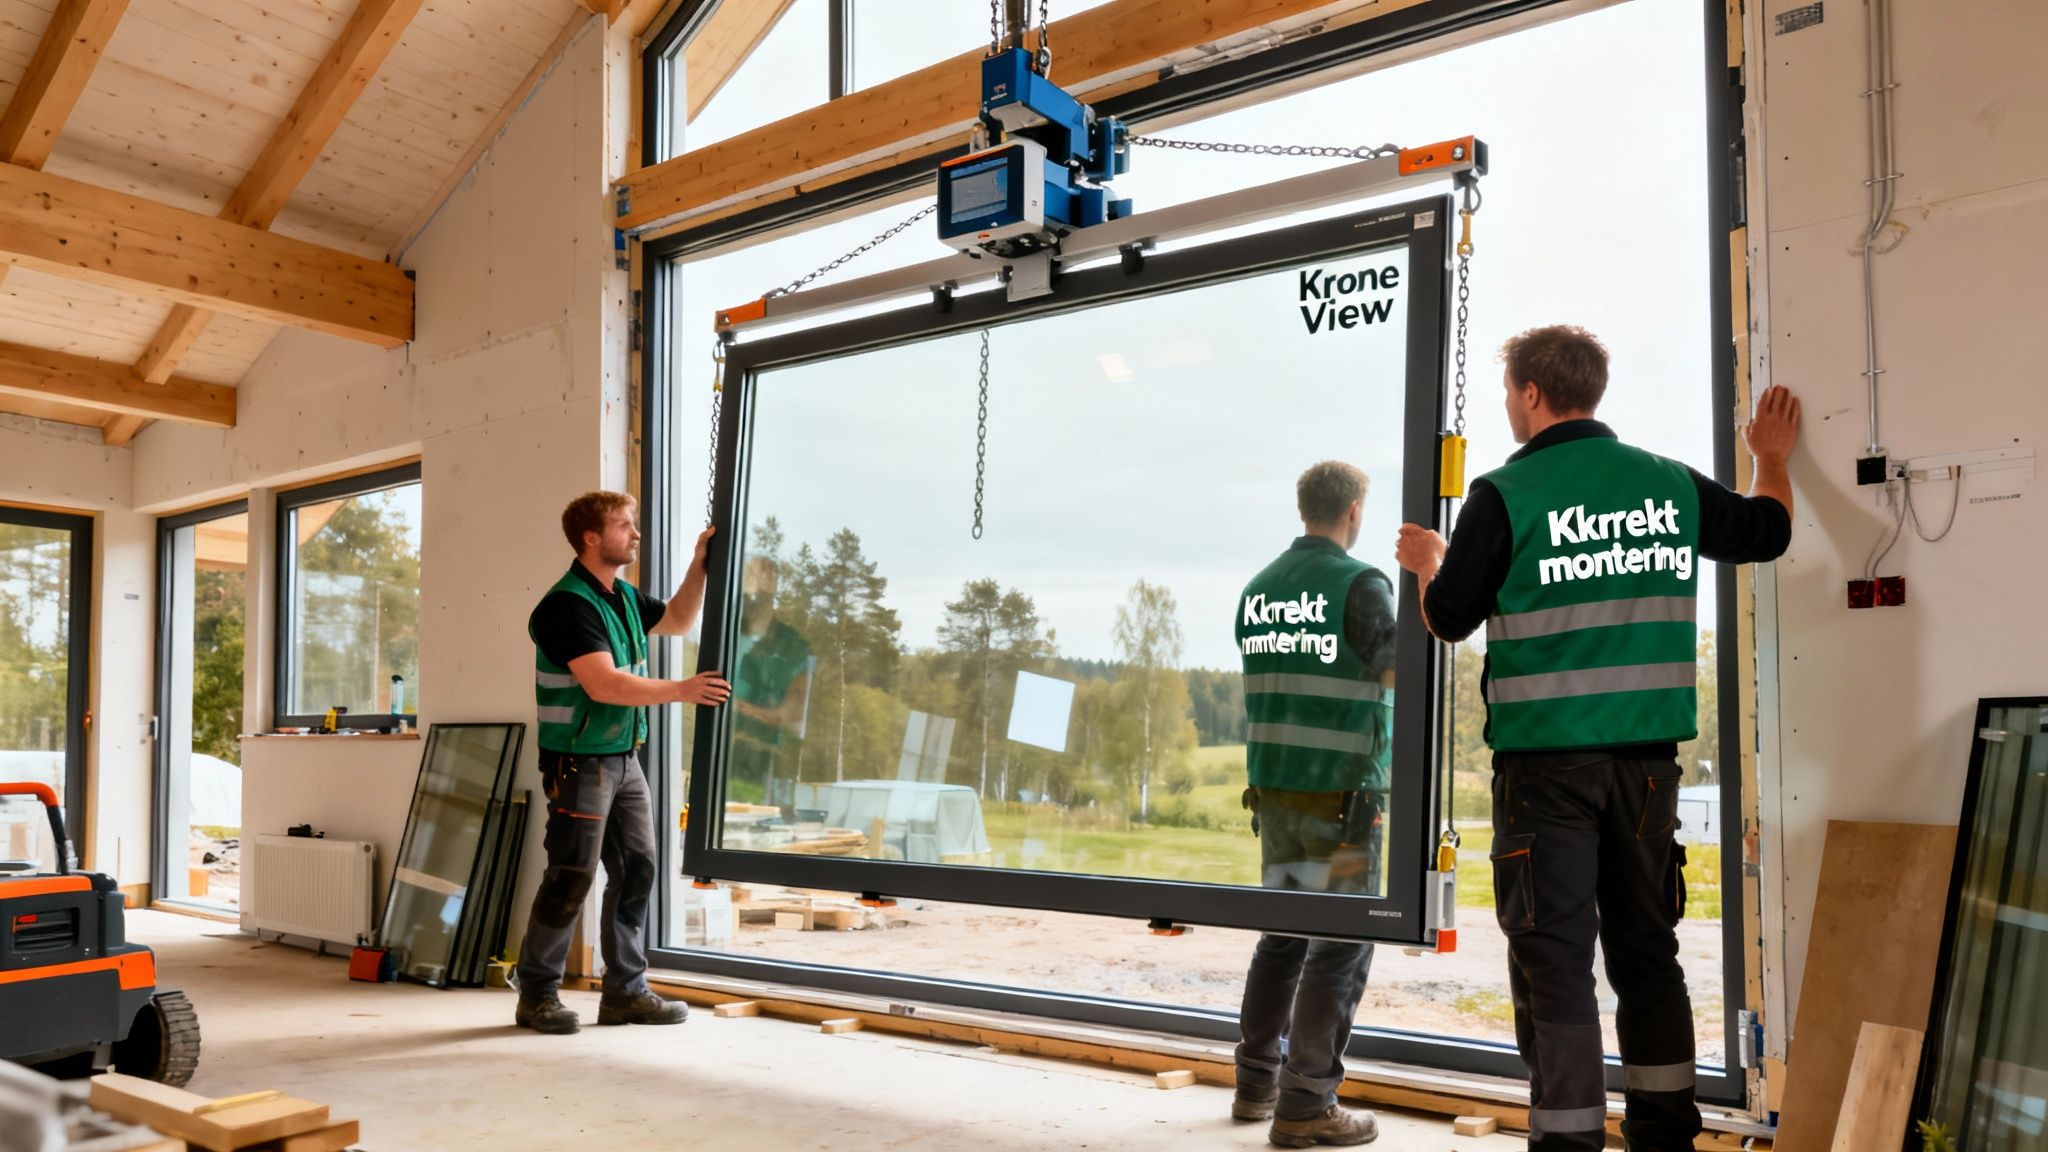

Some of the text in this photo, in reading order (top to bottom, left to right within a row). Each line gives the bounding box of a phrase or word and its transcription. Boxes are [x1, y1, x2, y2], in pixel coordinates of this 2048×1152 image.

[1300, 265, 1399, 301] Krone
[1300, 298, 1394, 334] View
[1539, 541, 1692, 585] montering
